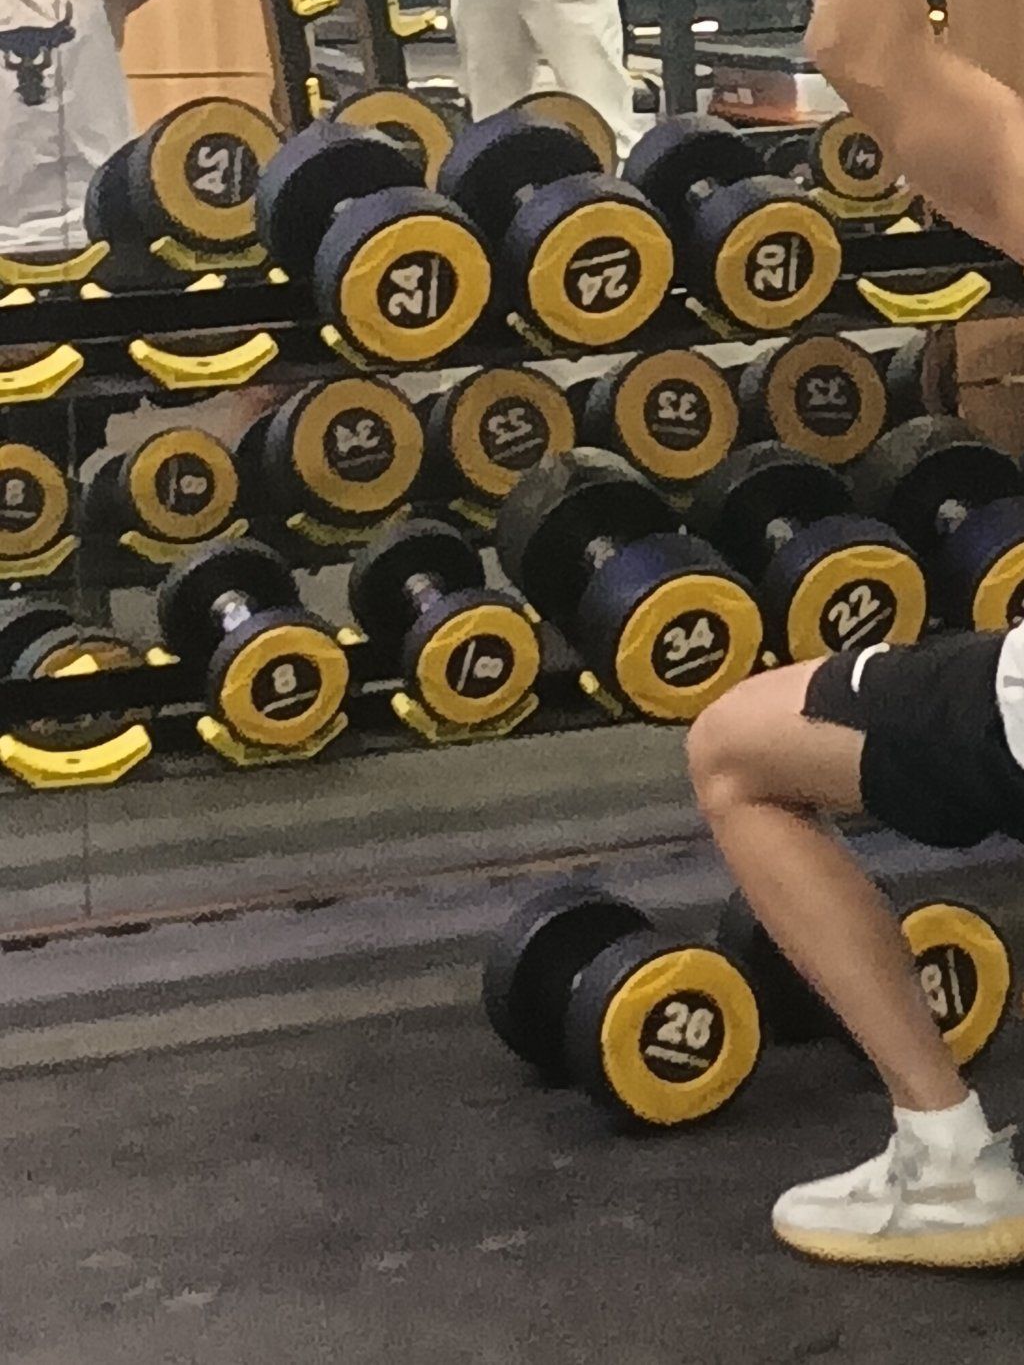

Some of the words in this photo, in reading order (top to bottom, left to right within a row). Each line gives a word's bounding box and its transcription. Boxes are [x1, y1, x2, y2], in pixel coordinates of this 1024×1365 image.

[387, 264, 425, 318] 24
[577, 266, 629, 305] 24
[754, 244, 786, 291] 20
[828, 584, 881, 636] 22
[663, 617, 716, 664] 34
